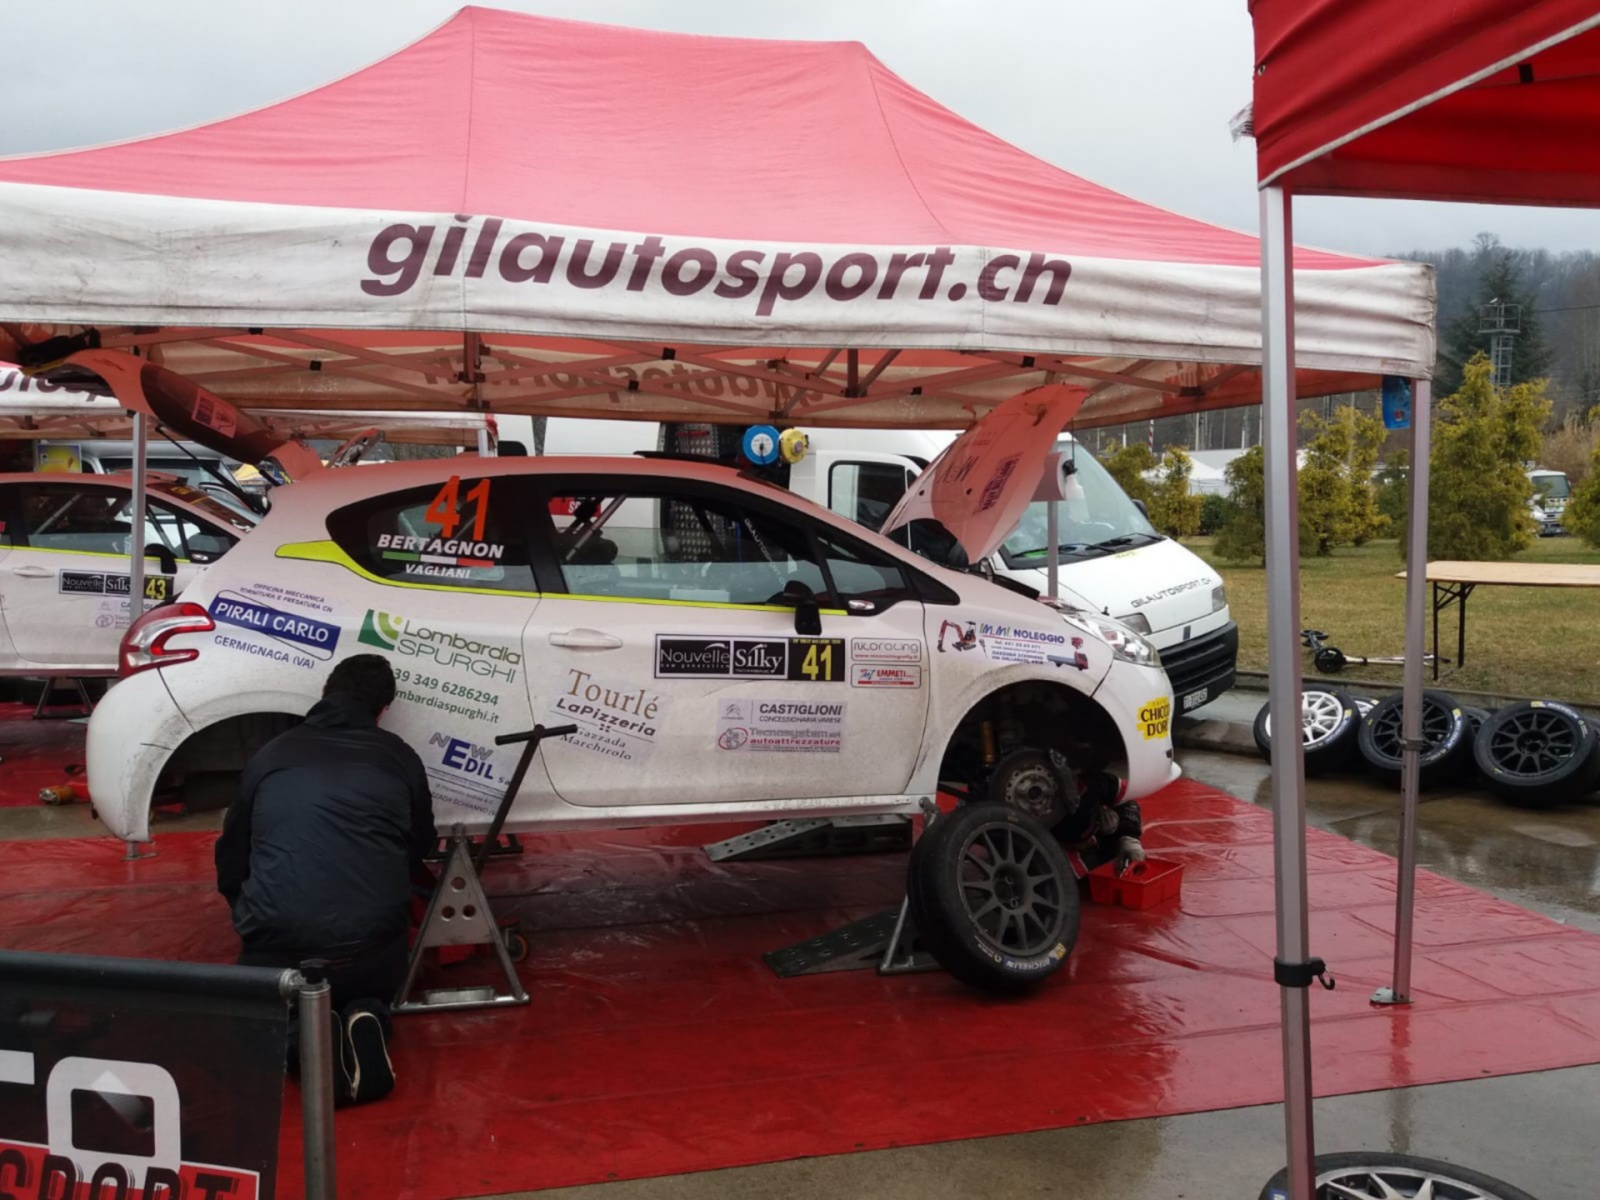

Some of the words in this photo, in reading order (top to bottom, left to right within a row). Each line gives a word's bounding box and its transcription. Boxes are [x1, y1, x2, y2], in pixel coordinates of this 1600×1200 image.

[360, 213, 1072, 316] gilautosport.ch
[424, 475, 491, 541] 41
[377, 534, 504, 559] BERTAGNON
[405, 563, 471, 579] VAGLIANI
[145, 578, 167, 600] 43
[239, 587, 276, 600] TORNITURA
[282, 595, 321, 610] FRESATURA
[253, 583, 284, 594] OFFICINA
[285, 589, 325, 603] MECCANICA
[215, 602, 269, 626] PIRALI
[272, 616, 329, 642] CARLO
[1013, 628, 1065, 644] NOLEGGIO
[214, 635, 289, 662] GERMIGNAGA
[292, 655, 315, 669] (VA)
[404, 620, 522, 665] Lombardia
[398, 639, 516, 684] SPURGHI
[660, 648, 730, 664] Nouvelle
[734, 646, 784, 673] Silky
[801, 644, 832, 680] 41
[876, 669, 907, 678] EMMETI
[412, 673, 439, 690] 349
[441, 681, 499, 706] 6286294
[567, 668, 659, 720] Tourlé
[394, 689, 500, 724] mbardiaspurghi.it
[556, 698, 656, 737] LaPizzeria
[759, 703, 843, 716] CASTIGLIONI
[759, 715, 816, 723] CONCESSIONARIA
[749, 737, 841, 746] autoattrezzature
[442, 738, 494, 780] EDIL
